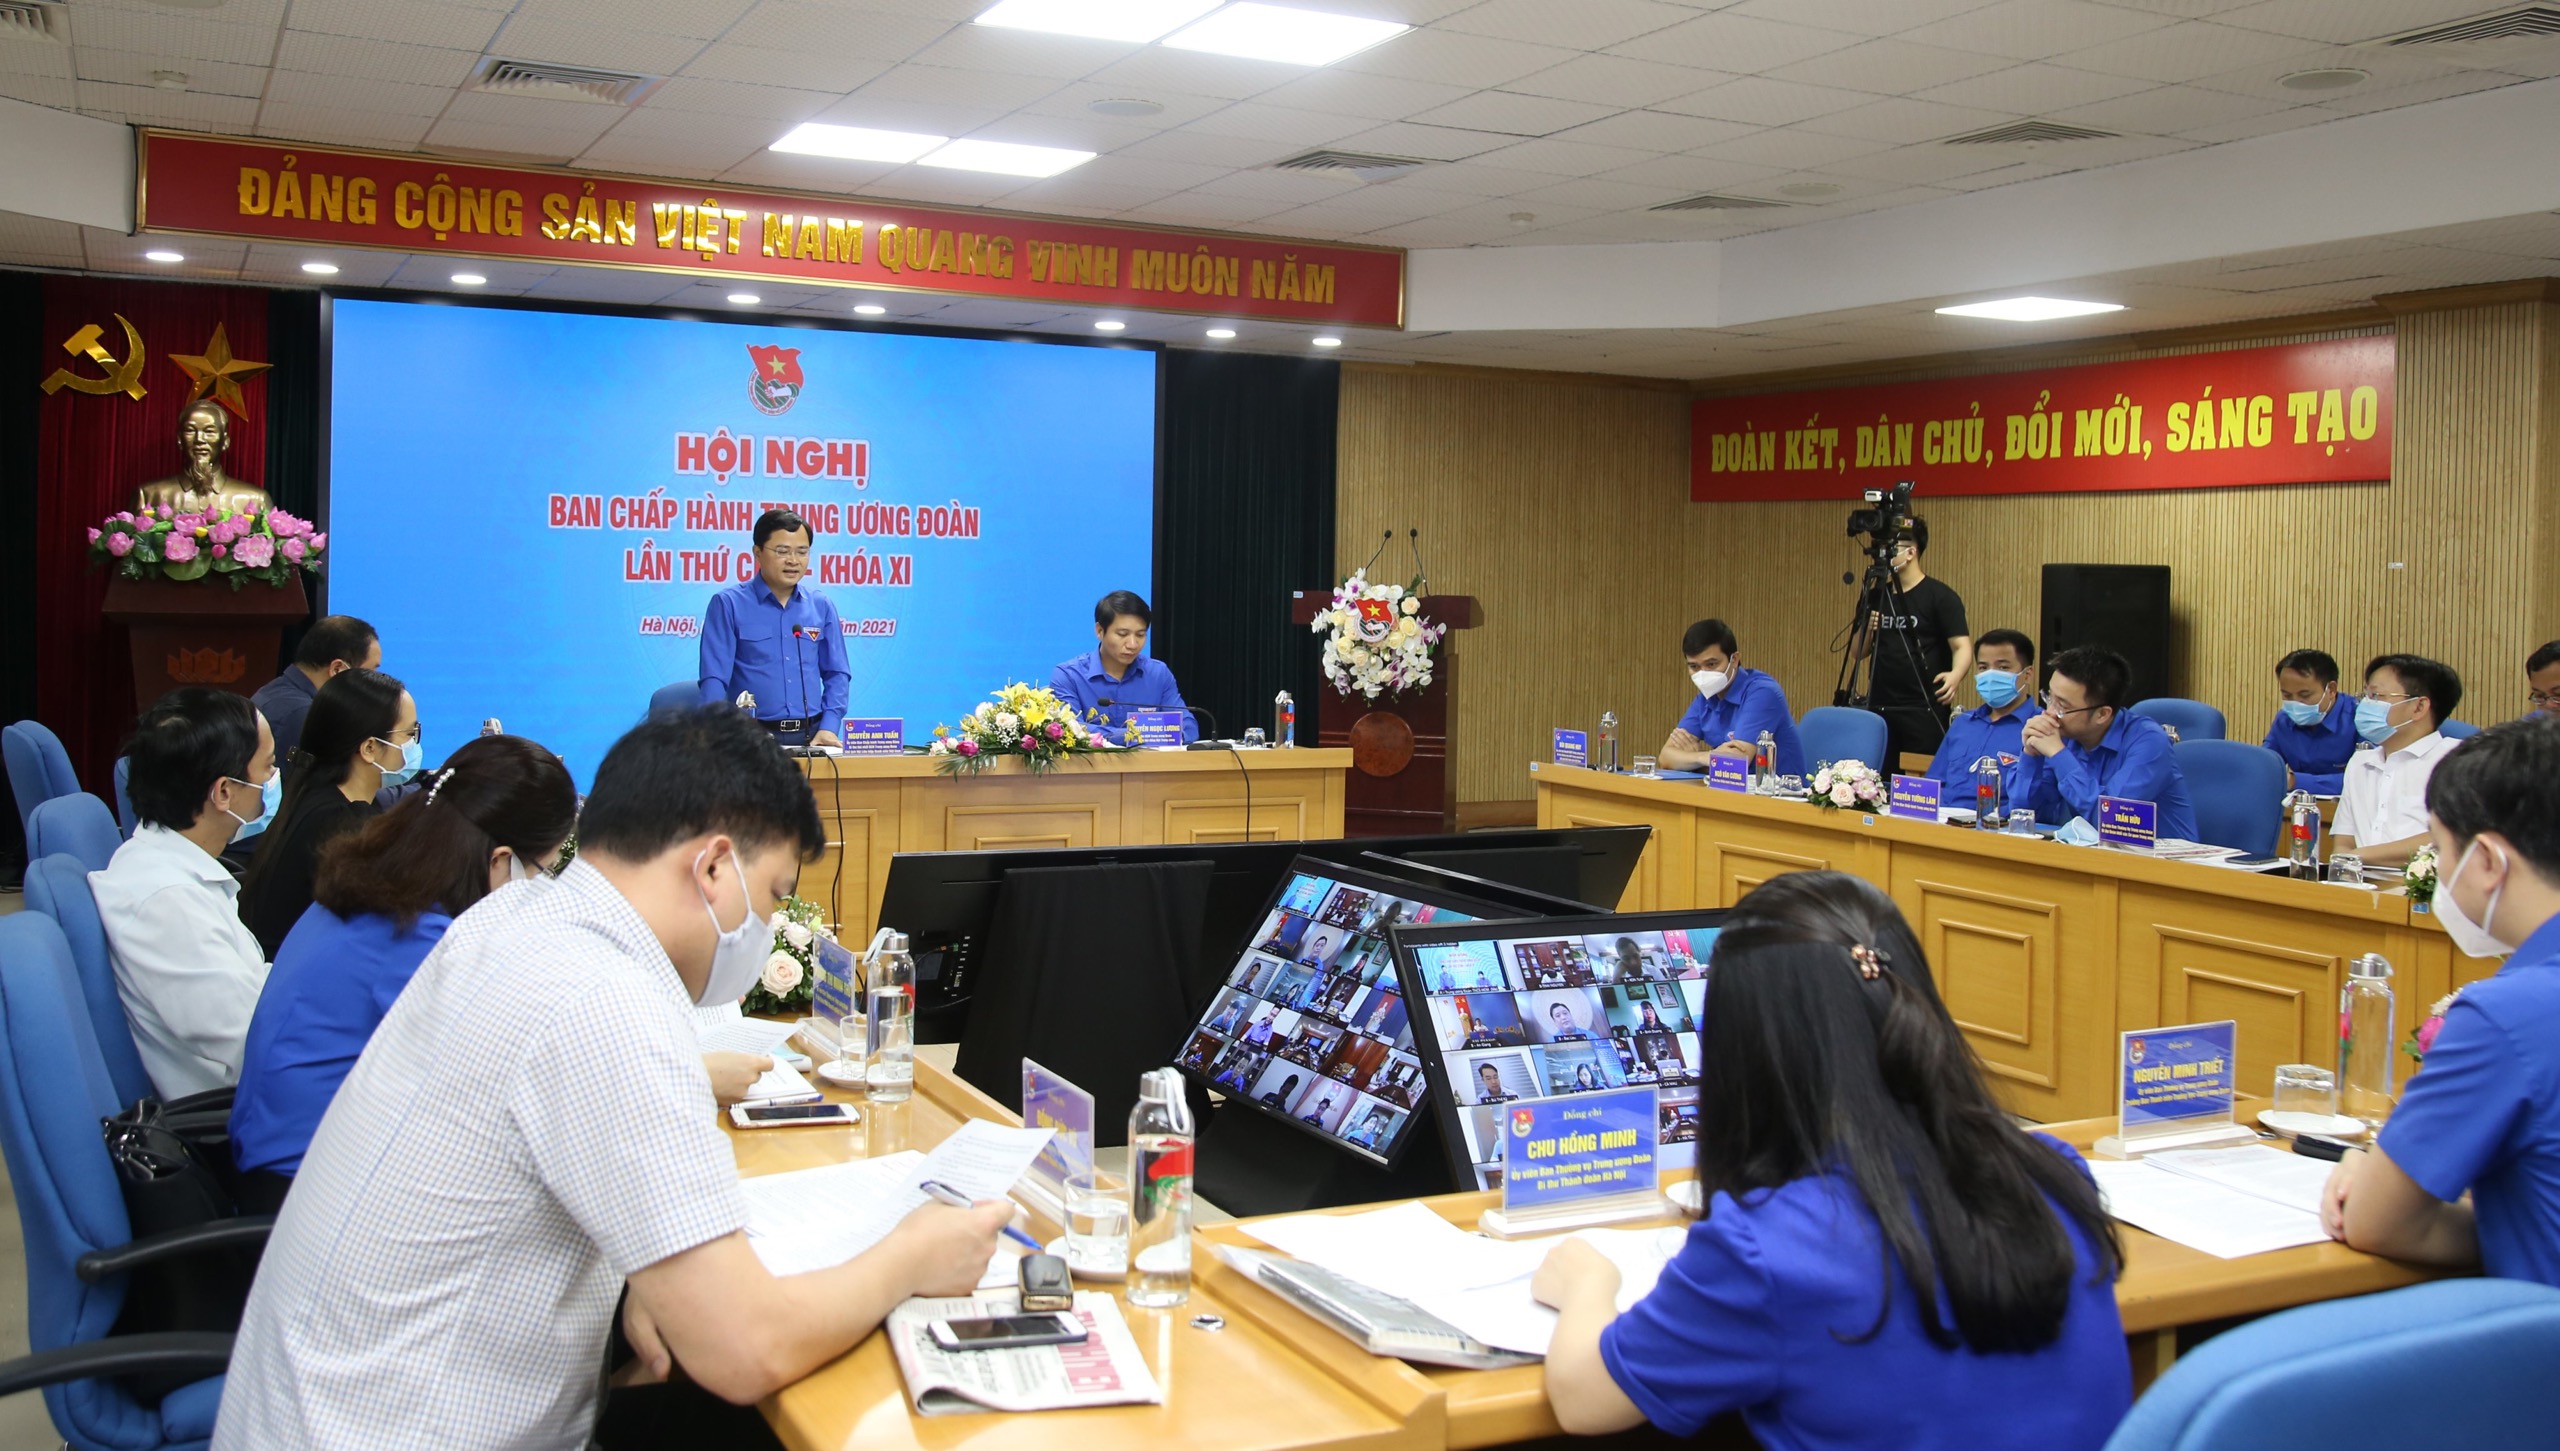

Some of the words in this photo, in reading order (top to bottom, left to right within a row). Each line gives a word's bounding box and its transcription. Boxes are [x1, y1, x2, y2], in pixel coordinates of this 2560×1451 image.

[238, 155, 376, 226] ĐẢNG
[394, 178, 523, 241] CỘNG
[540, 182, 636, 246] SẢN
[652, 199, 747, 261] VIỆT
[762, 212, 864, 265] NAM
[878, 223, 1014, 279] QUANG
[1029, 240, 1118, 288] VINH
[1130, 245, 1239, 297] MUÔN
[1251, 255, 1335, 304] NĂM
[1711, 427, 1775, 473] ĐOÀN
[1783, 412, 1845, 474] KẾT,
[1855, 414, 1912, 470] DÂN
[1923, 401, 1993, 470] CHỦ,
[2005, 389, 2061, 461] ĐỔI
[2074, 393, 2151, 460] MỚI,
[2166, 386, 2272, 451] SÁNG
[2288, 386, 2378, 457] TẠO
[678, 430, 752, 482] HỘI
[766, 438, 868, 487] NGHỊ
[550, 496, 601, 527] BAN
[610, 488, 677, 531] CHẤP
[686, 493, 752, 531] HÀNH
[760, 503, 839, 534] UNG
[847, 503, 910, 536] ƯƠNG
[917, 502, 979, 537] ĐOÀN
[625, 539, 669, 581] LẦN
[680, 548, 727, 582] THỨ
[821, 548, 882, 585] KHÓA
[889, 556, 911, 585] XI
[641, 618, 663, 632] Hà
[667, 618, 697, 635] Nội,
[861, 620, 895, 634] 2021
[1880, 613, 1919, 630] ENZ
[2133, 1061, 2171, 1084] NGUYỄN
[2172, 1062, 2198, 1078] MINH
[2198, 1055, 2224, 1076] TRIẾT
[1563, 1109, 1586, 1120] Đồng
[1588, 1107, 1602, 1118] chí
[1527, 1138, 1556, 1159] CHU
[1559, 1130, 1598, 1155] HỒNG
[1600, 1128, 1637, 1150] MINH
[1522, 1168, 1538, 1178] viên
[1540, 1166, 1554, 1177] Ban
[1593, 1159, 1614, 1170] Trung
[1632, 1153, 1652, 1164] Đoàn
[1560, 1175, 1582, 1187] Thành
[1602, 1171, 1612, 1182] Hà
[1613, 1169, 1626, 1182] Nội
